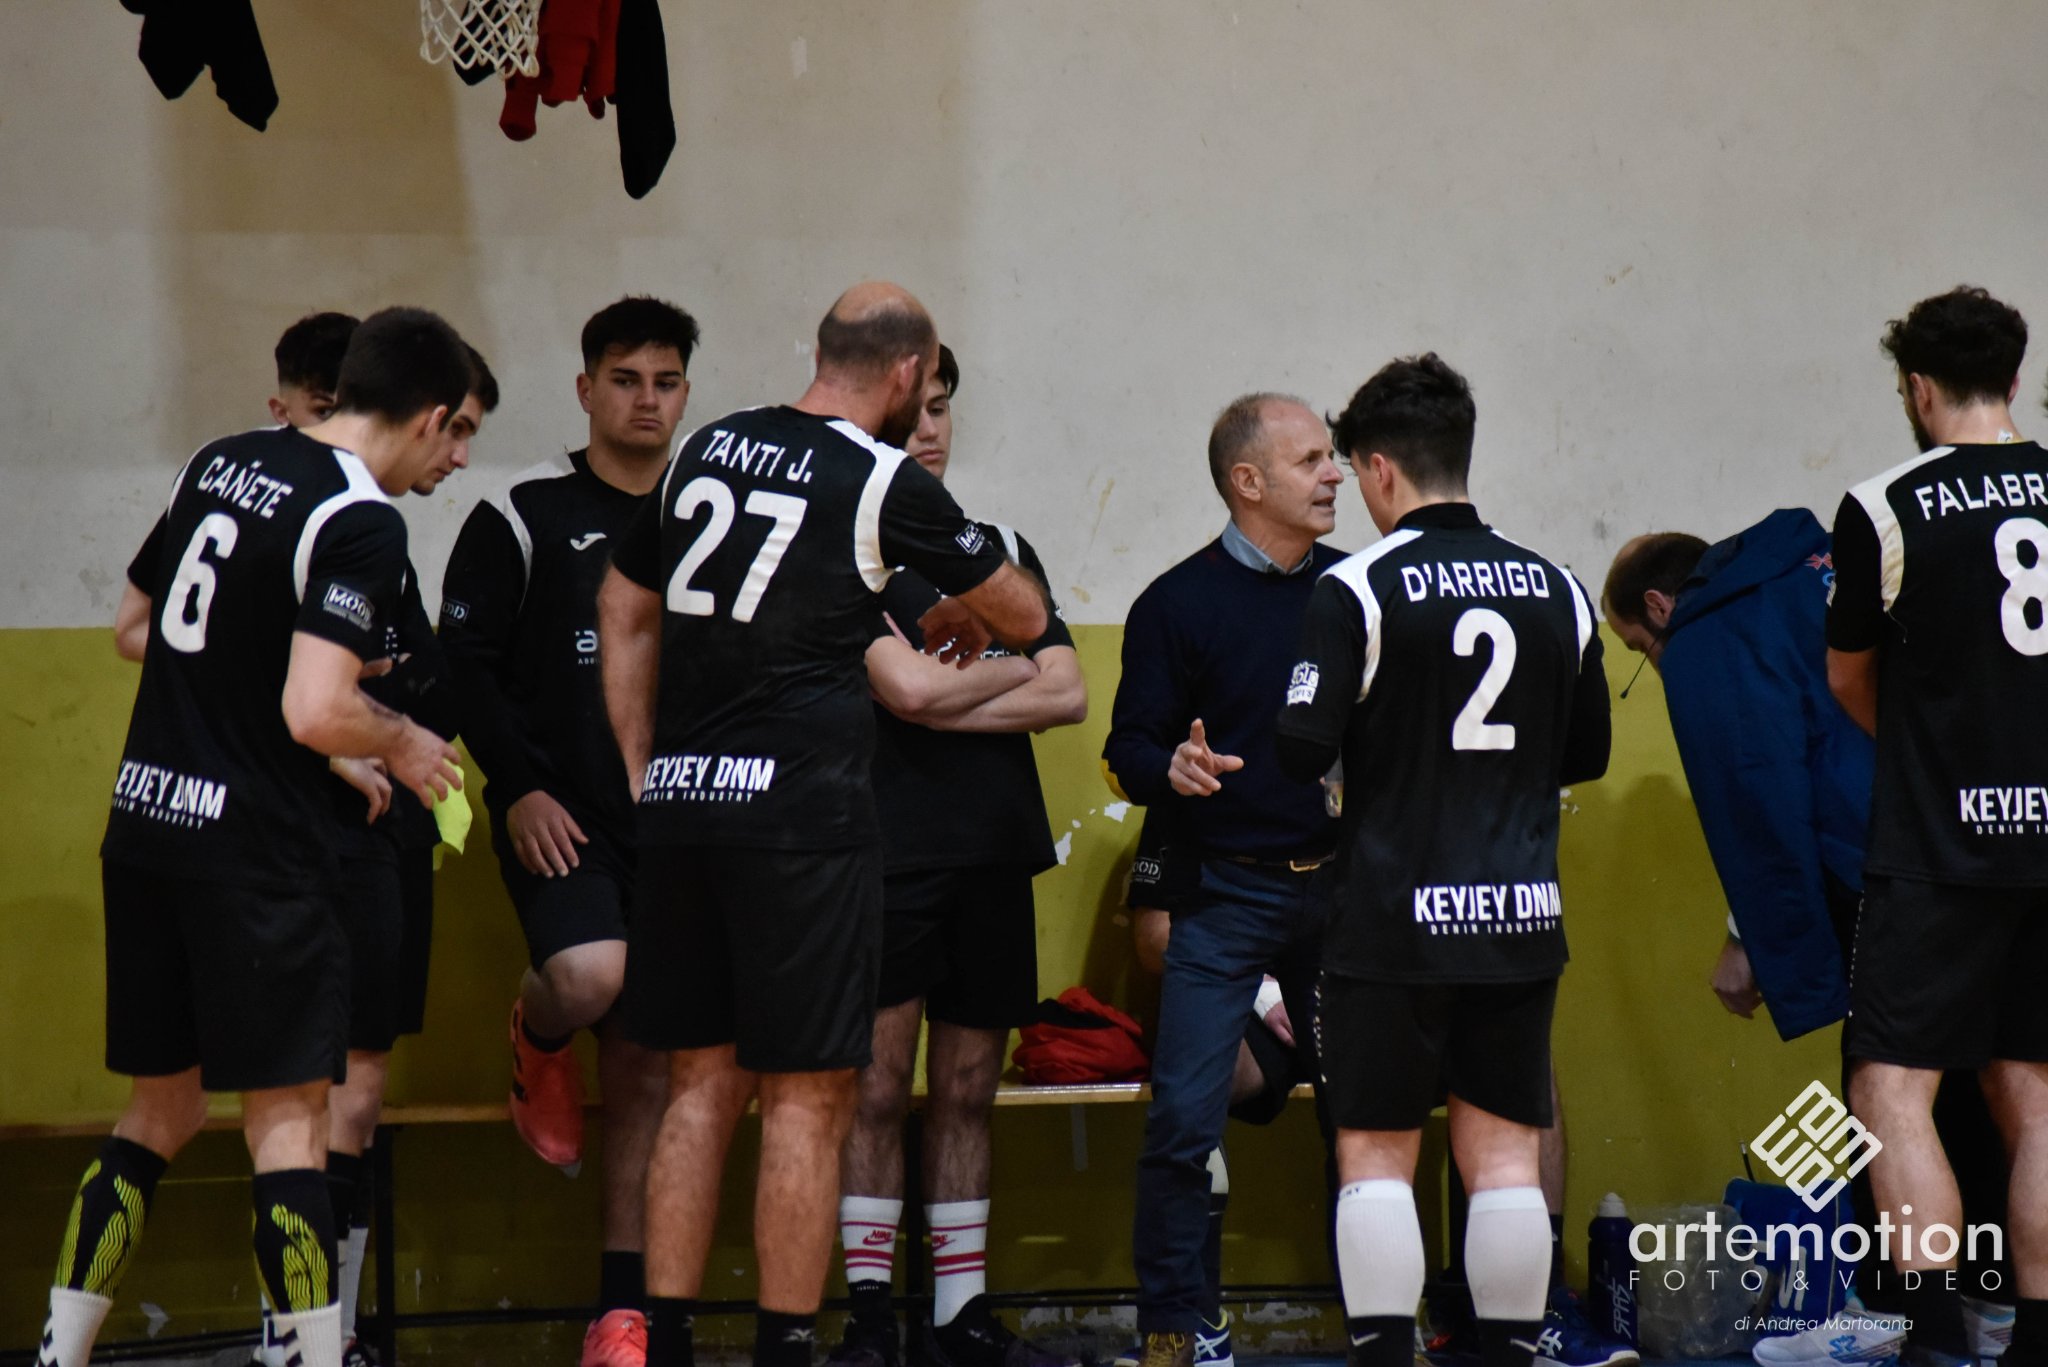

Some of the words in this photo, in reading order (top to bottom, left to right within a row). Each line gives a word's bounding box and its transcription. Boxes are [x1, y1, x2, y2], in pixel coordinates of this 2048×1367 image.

[702, 430, 786, 477] TANTI
[787, 449, 813, 483] J.
[1915, 473, 2048, 521] FALABR
[667, 476, 808, 623] 27
[161, 513, 239, 653] 6
[1401, 561, 1550, 602] D'ARRIGO
[1994, 517, 2048, 656] 8
[1452, 607, 1517, 750] 2
[114, 760, 174, 806] EYJEY
[712, 756, 775, 792] DNM
[1976, 823, 2024, 835] DENIM
[1414, 885, 1508, 923] KEYJEY
[1430, 922, 1478, 935] DENIM
[1487, 919, 1557, 935] INDUSTRY
